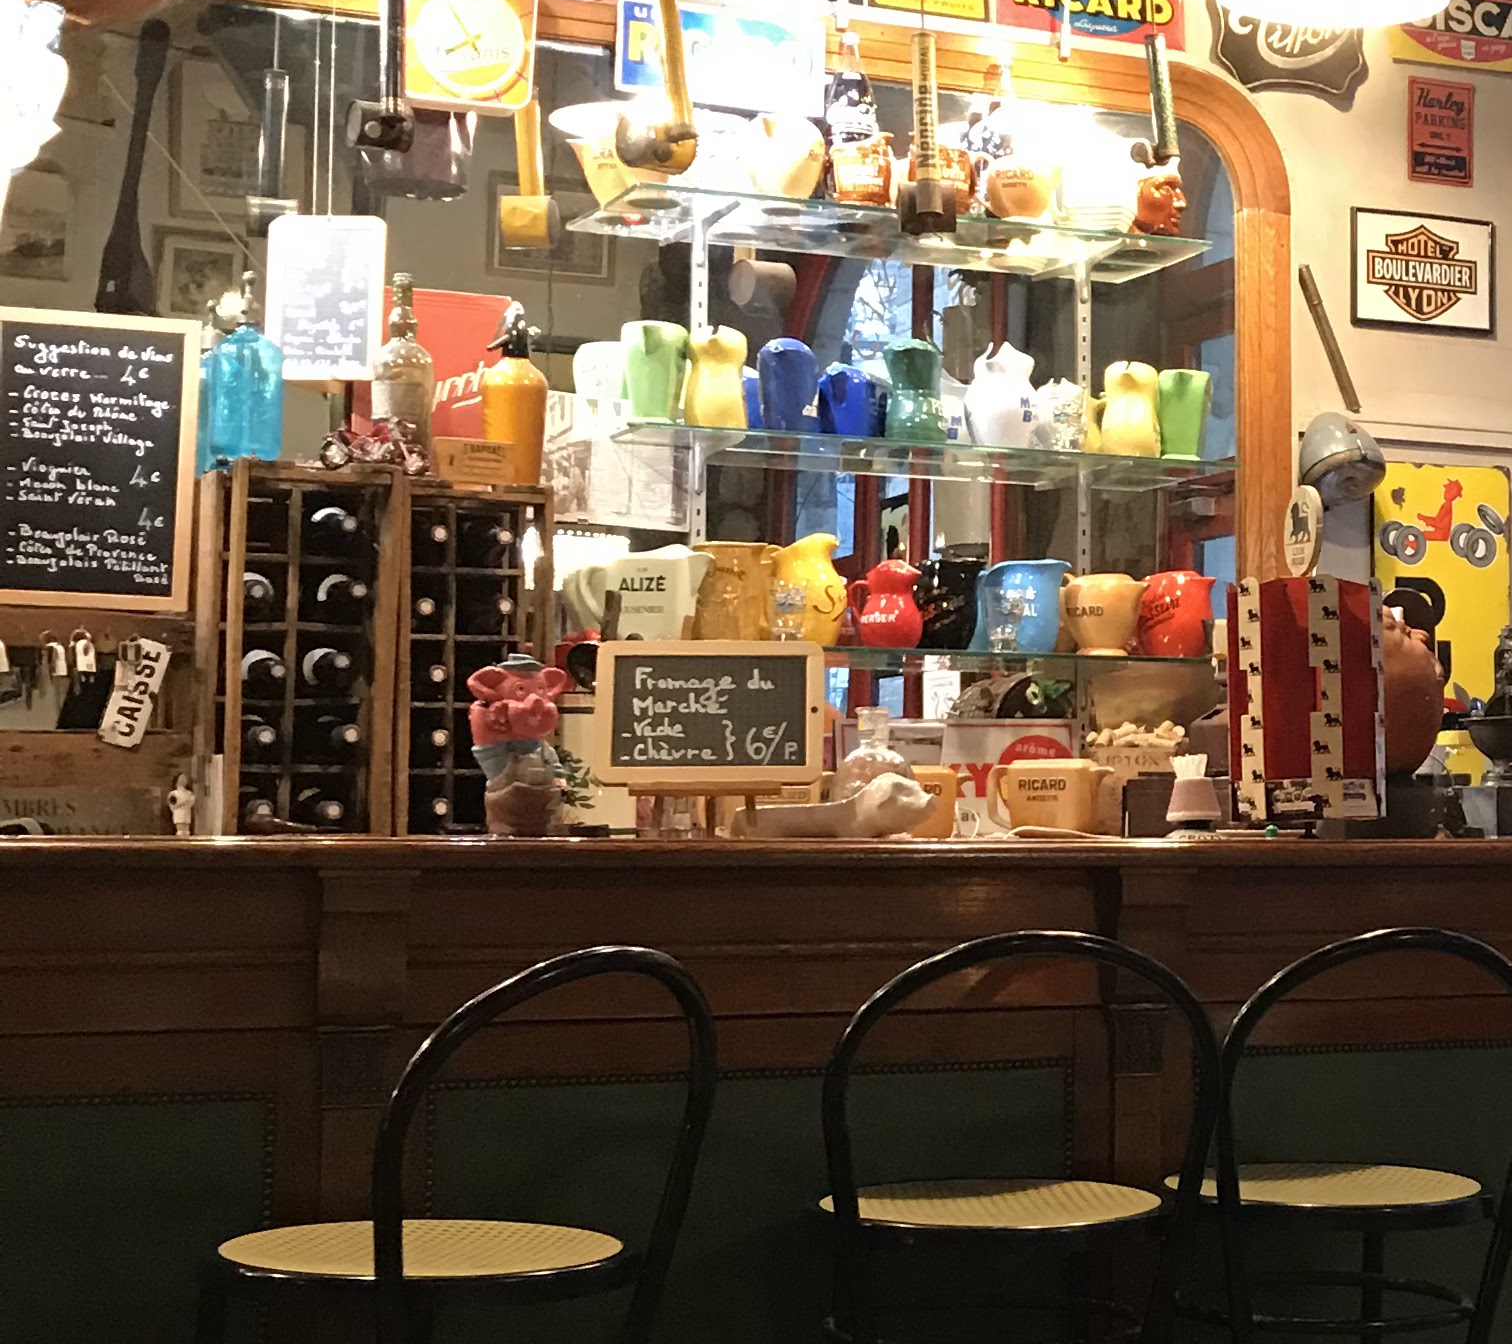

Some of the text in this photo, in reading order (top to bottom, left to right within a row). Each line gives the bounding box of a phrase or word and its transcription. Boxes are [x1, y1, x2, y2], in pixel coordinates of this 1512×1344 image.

[1416, 87, 1465, 115] Harley
[1415, 112, 1466, 129] PARKING
[1398, 234, 1443, 258] HOTEL
[1374, 258, 1470, 287] BOULEVARDIER
[1399, 287, 1449, 313] LYON
[14, 335, 111, 363] Suggestion
[118, 346, 138, 360] de
[40, 366, 91, 379] verre
[68, 405, 86, 418] du
[90, 392, 170, 418] Hermitage
[18, 490, 63, 501] Saint
[66, 544, 83, 555] de
[619, 575, 666, 592] ALIZÉ
[116, 649, 162, 737] CAISSE
[634, 667, 775, 705] Fromage du
[632, 693, 728, 716] Marché
[633, 738, 717, 760] Chèvre
[1018, 777, 1067, 791] RICARD
